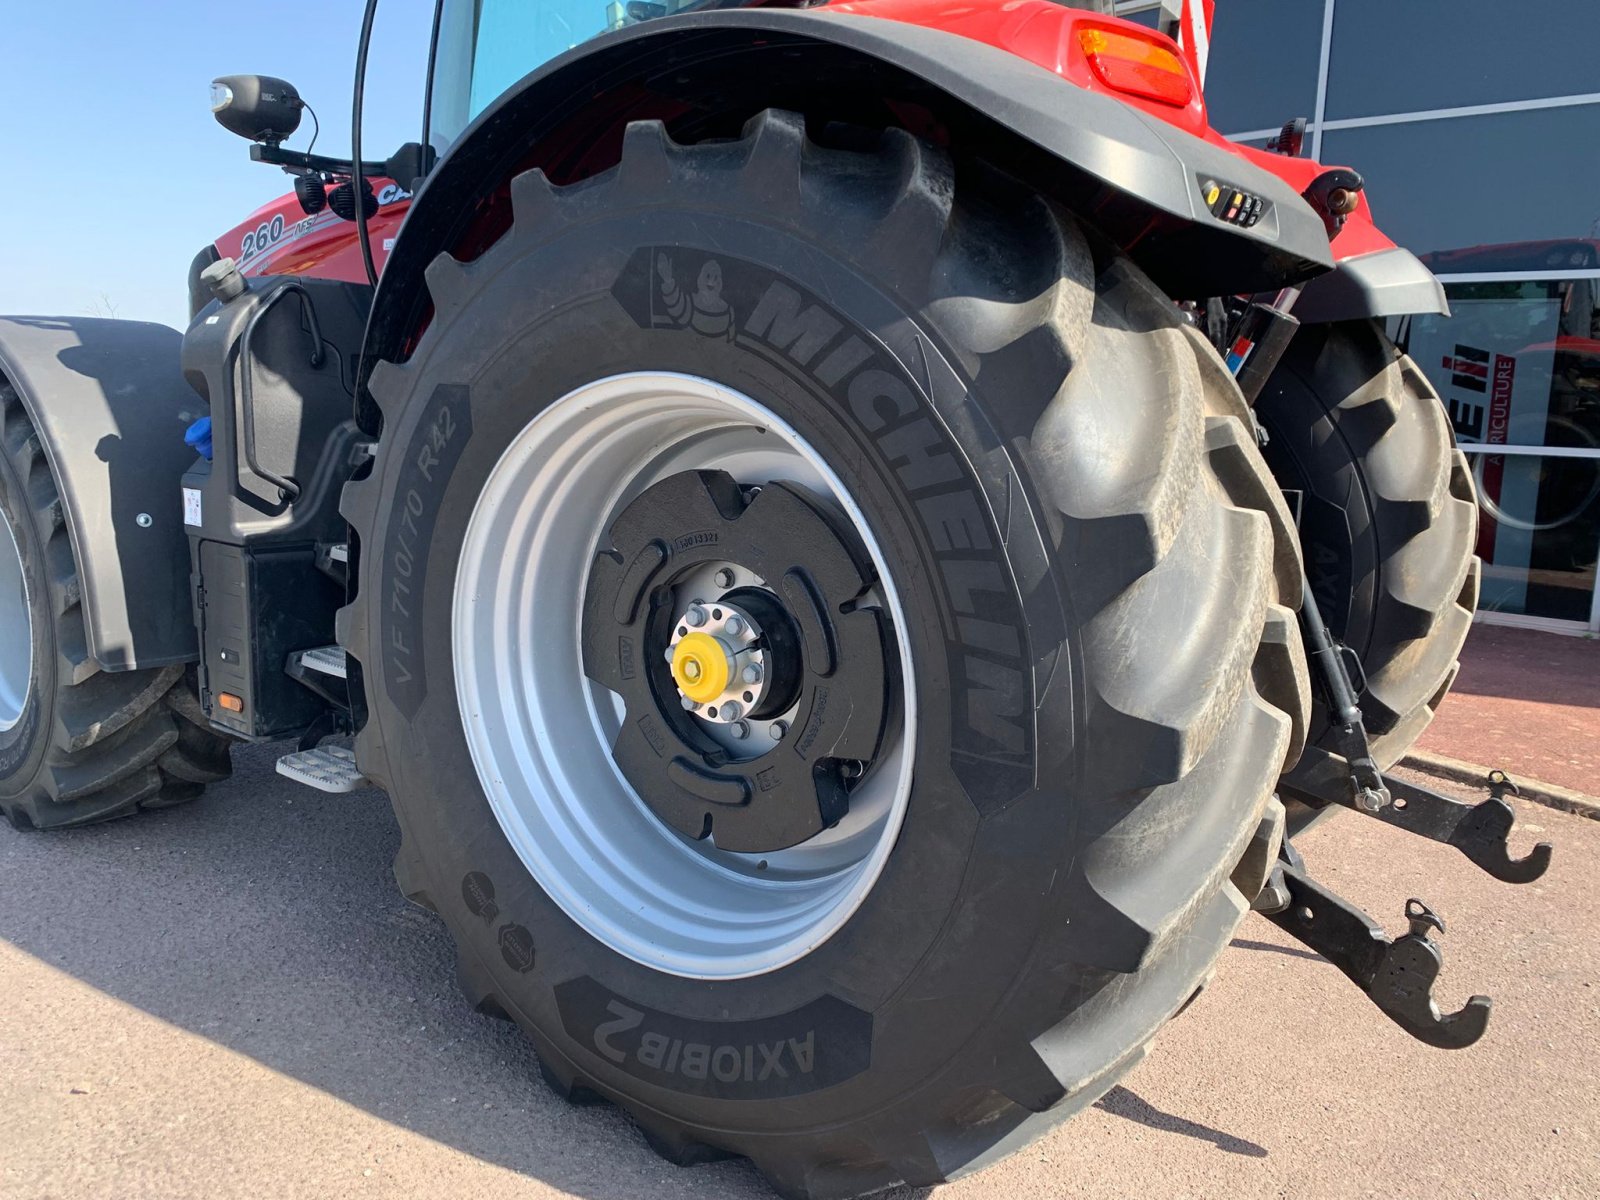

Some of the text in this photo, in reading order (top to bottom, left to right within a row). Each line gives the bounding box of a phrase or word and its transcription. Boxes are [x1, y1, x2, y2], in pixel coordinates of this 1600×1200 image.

[242, 214, 284, 262] 260
[1488, 360, 1512, 465] ARICULTURE
[392, 490, 424, 619] 710/70
[417, 406, 456, 482] R42
[744, 278, 1027, 756] MICHELIN
[594, 1000, 645, 1063] 2
